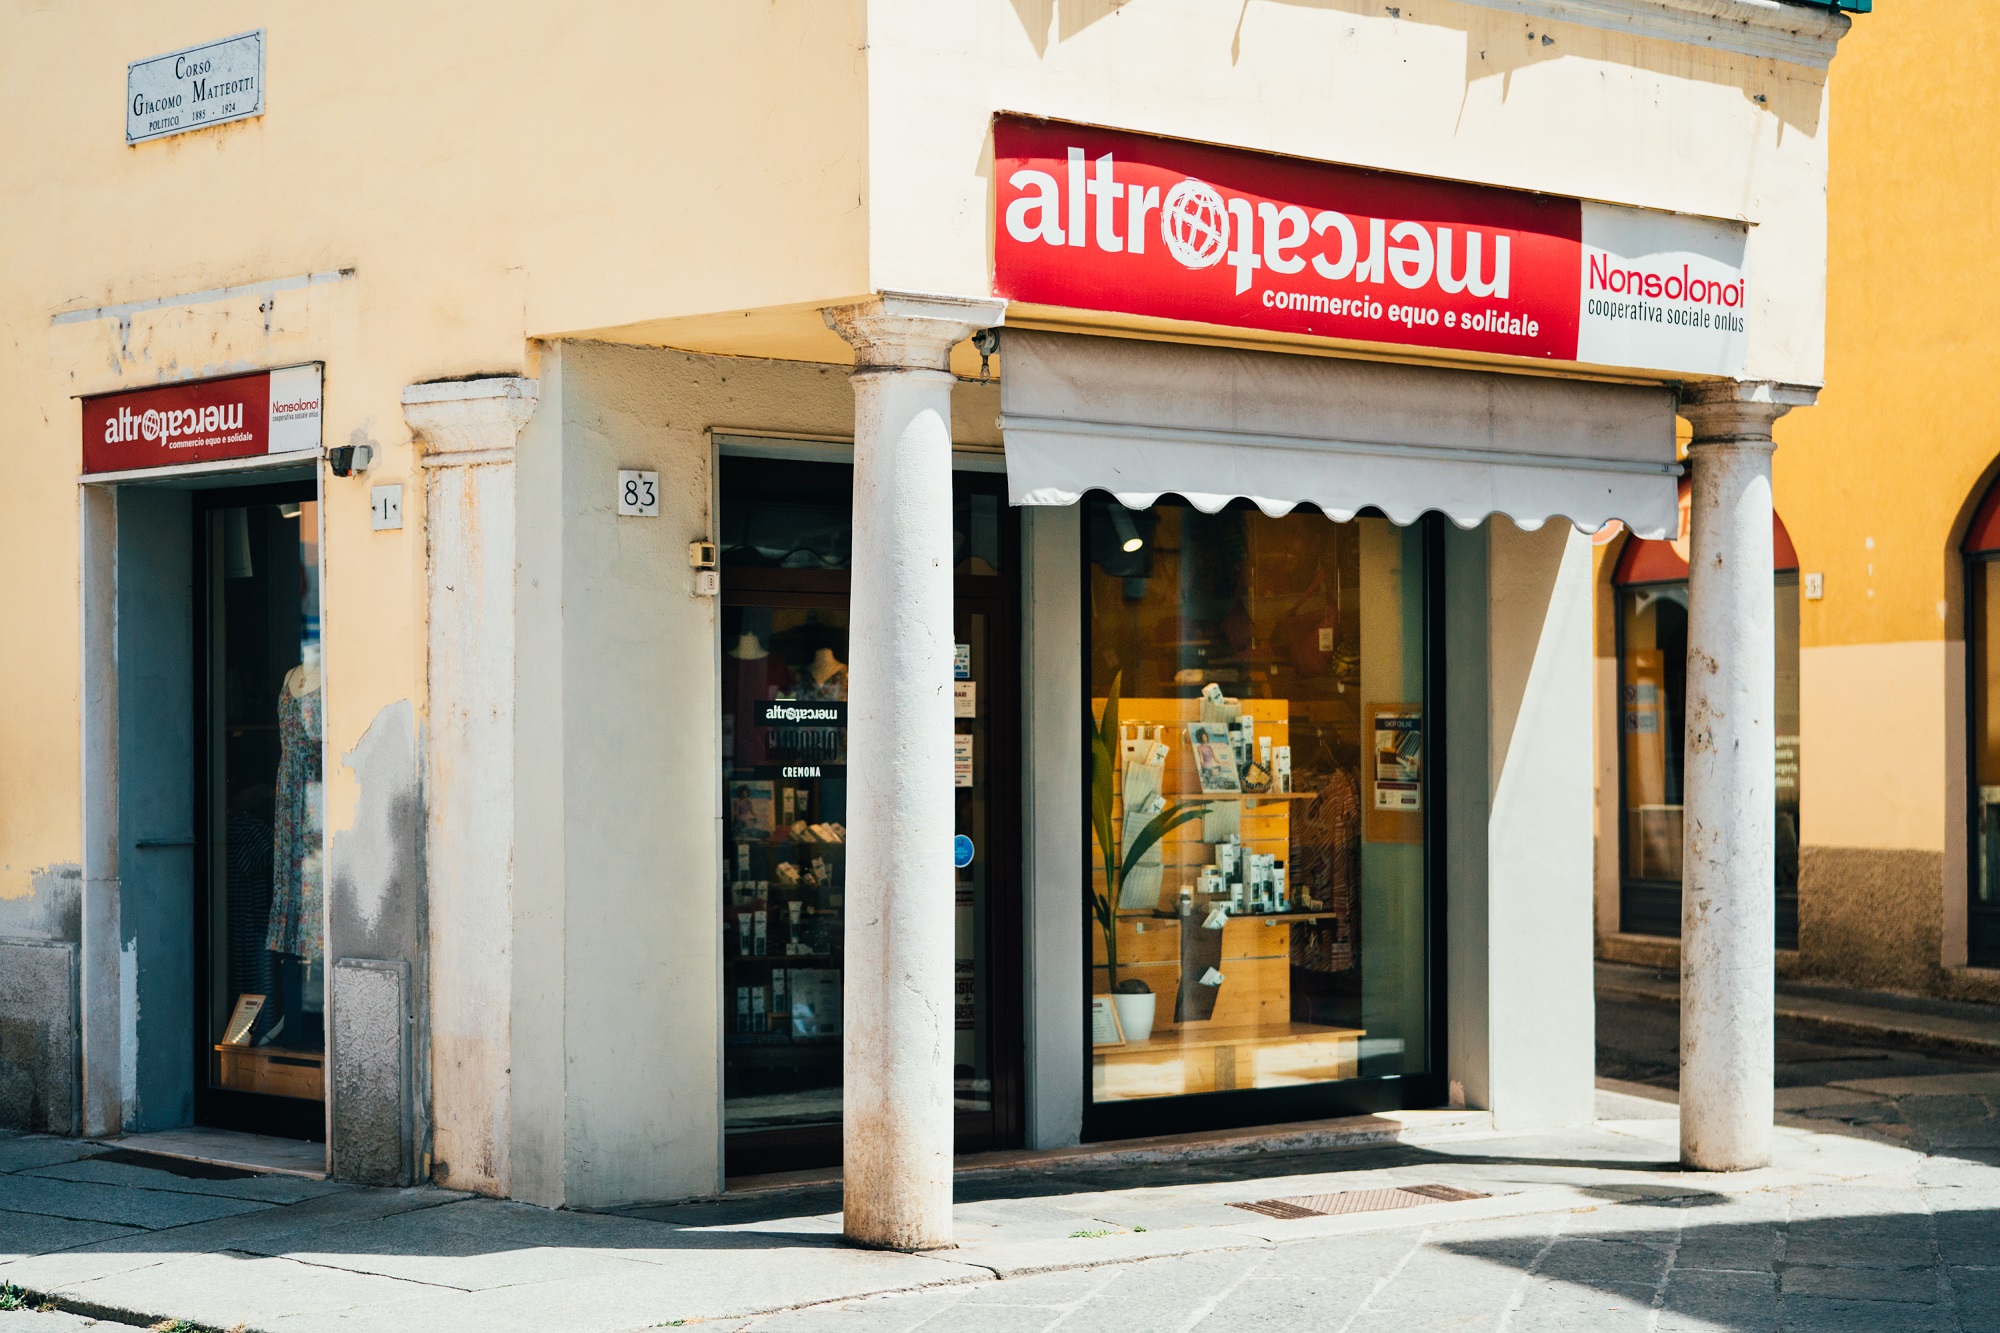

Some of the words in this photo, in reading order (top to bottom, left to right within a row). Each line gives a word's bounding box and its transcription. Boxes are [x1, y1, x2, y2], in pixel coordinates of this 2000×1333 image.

[149, 116, 180, 132] POLITICO
[192, 110, 206, 122] 1885
[221, 103, 236, 114] 1924
[1589, 253, 1745, 308] Nonsolonoi
[1262, 289, 1383, 319] commercio
[1388, 304, 1439, 328] equo
[1444, 310, 1457, 328] e
[1460, 309, 1539, 337] solidale
[1588, 298, 1662, 322] cooperativa
[1667, 307, 1710, 329] sociale
[1714, 312, 1744, 333] onlus
[272, 397, 319, 414] Nonsolonoi
[272, 413, 294, 422] cooperativa
[294, 411, 308, 420] sociale
[168, 436, 205, 450] commercio
[205, 436, 221, 447] equo
[222, 436, 227, 444] e
[227, 431, 253, 443] solidale
[624, 480, 656, 507] 83
[782, 766, 821, 778] CREMONA
